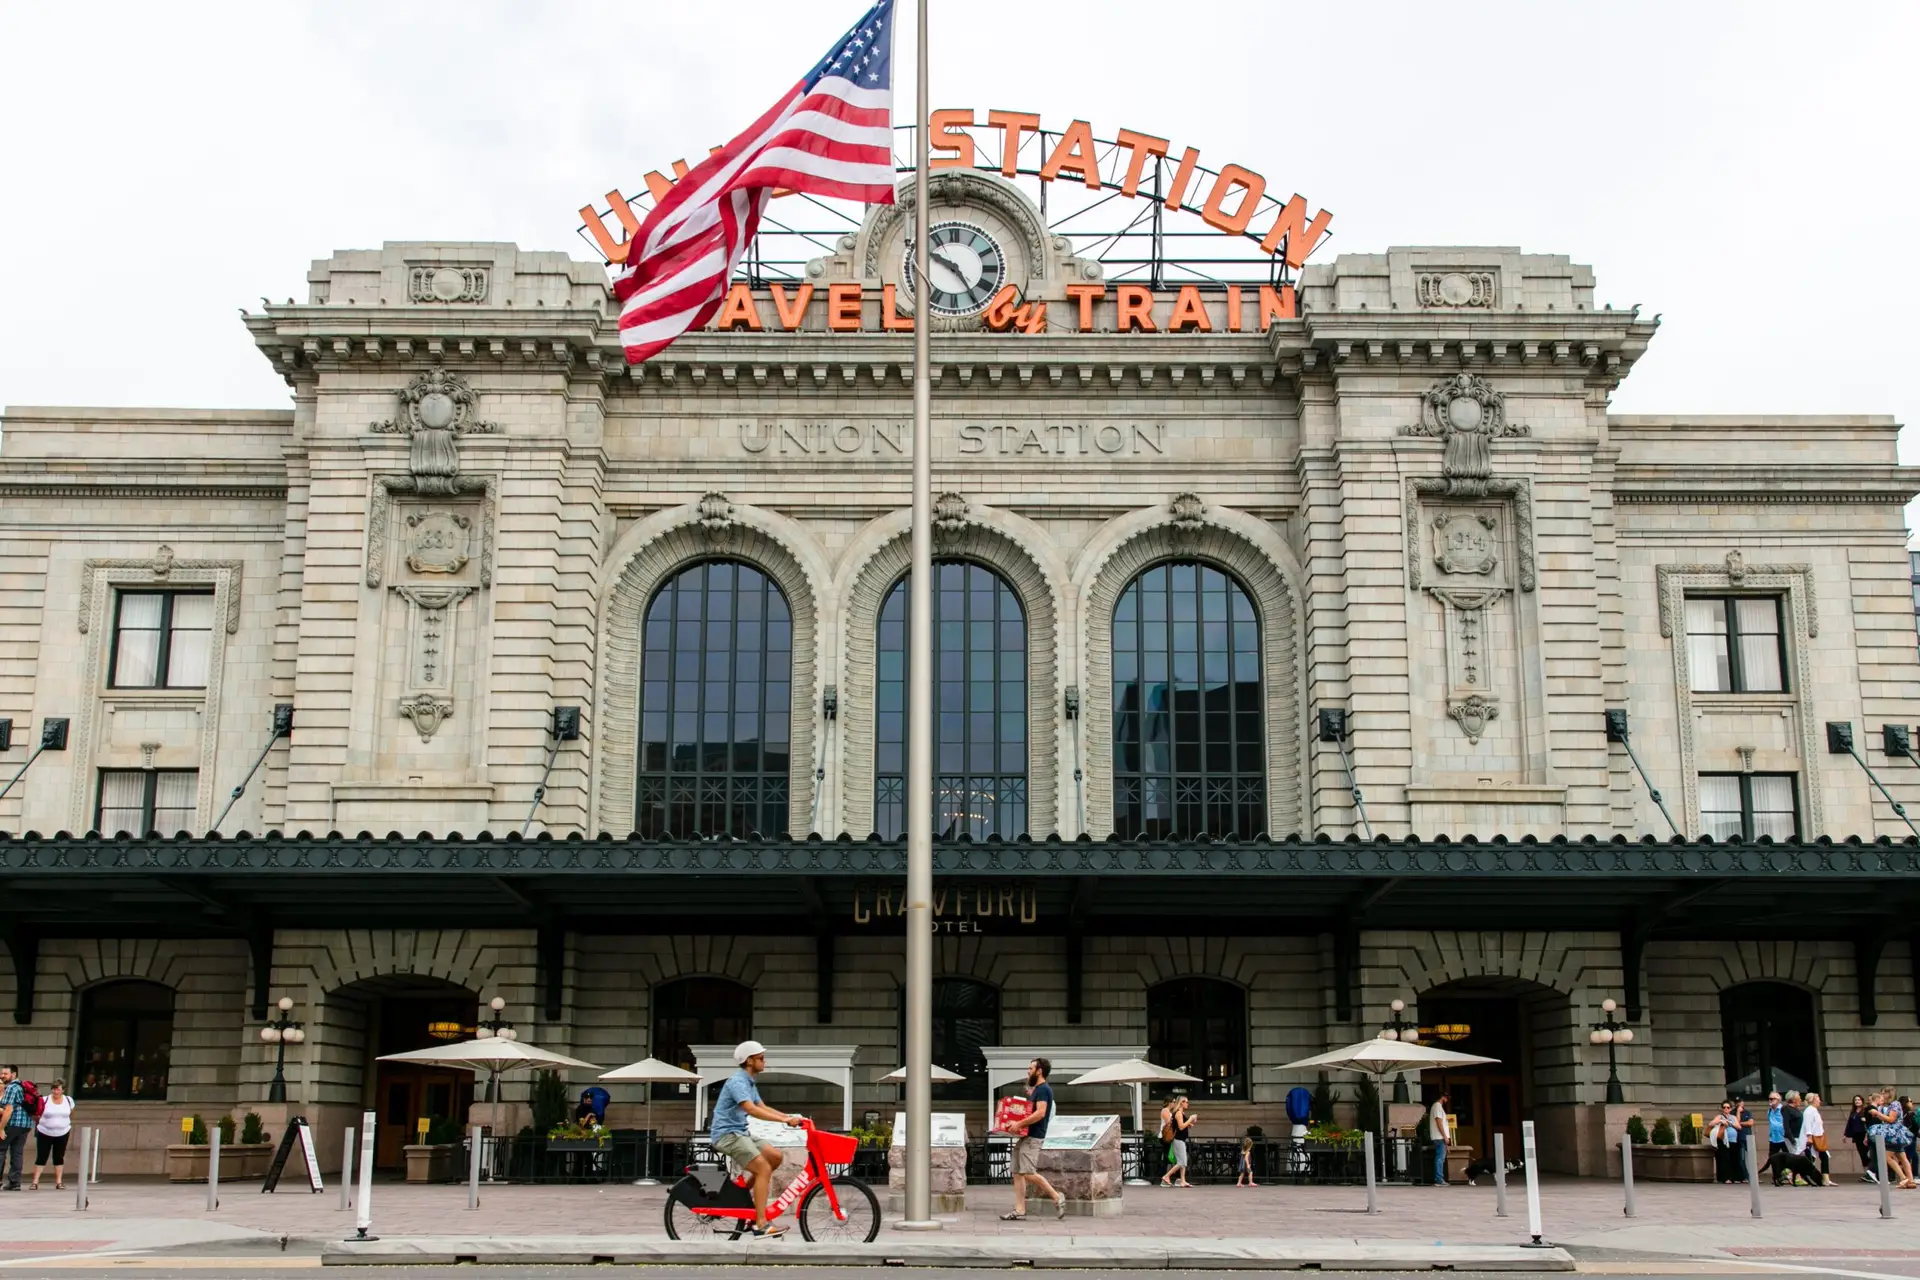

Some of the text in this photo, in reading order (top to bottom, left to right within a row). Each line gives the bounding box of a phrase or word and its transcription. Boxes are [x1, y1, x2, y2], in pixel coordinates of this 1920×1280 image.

[929, 108, 1333, 270] STATION
[717, 283, 1296, 334] AVEL by TRAIN
[739, 424, 1165, 454] UNION STATION
[416, 530, 454, 549] 1881
[931, 921, 983, 933] OTEL
[777, 1169, 810, 1211] JUMP
